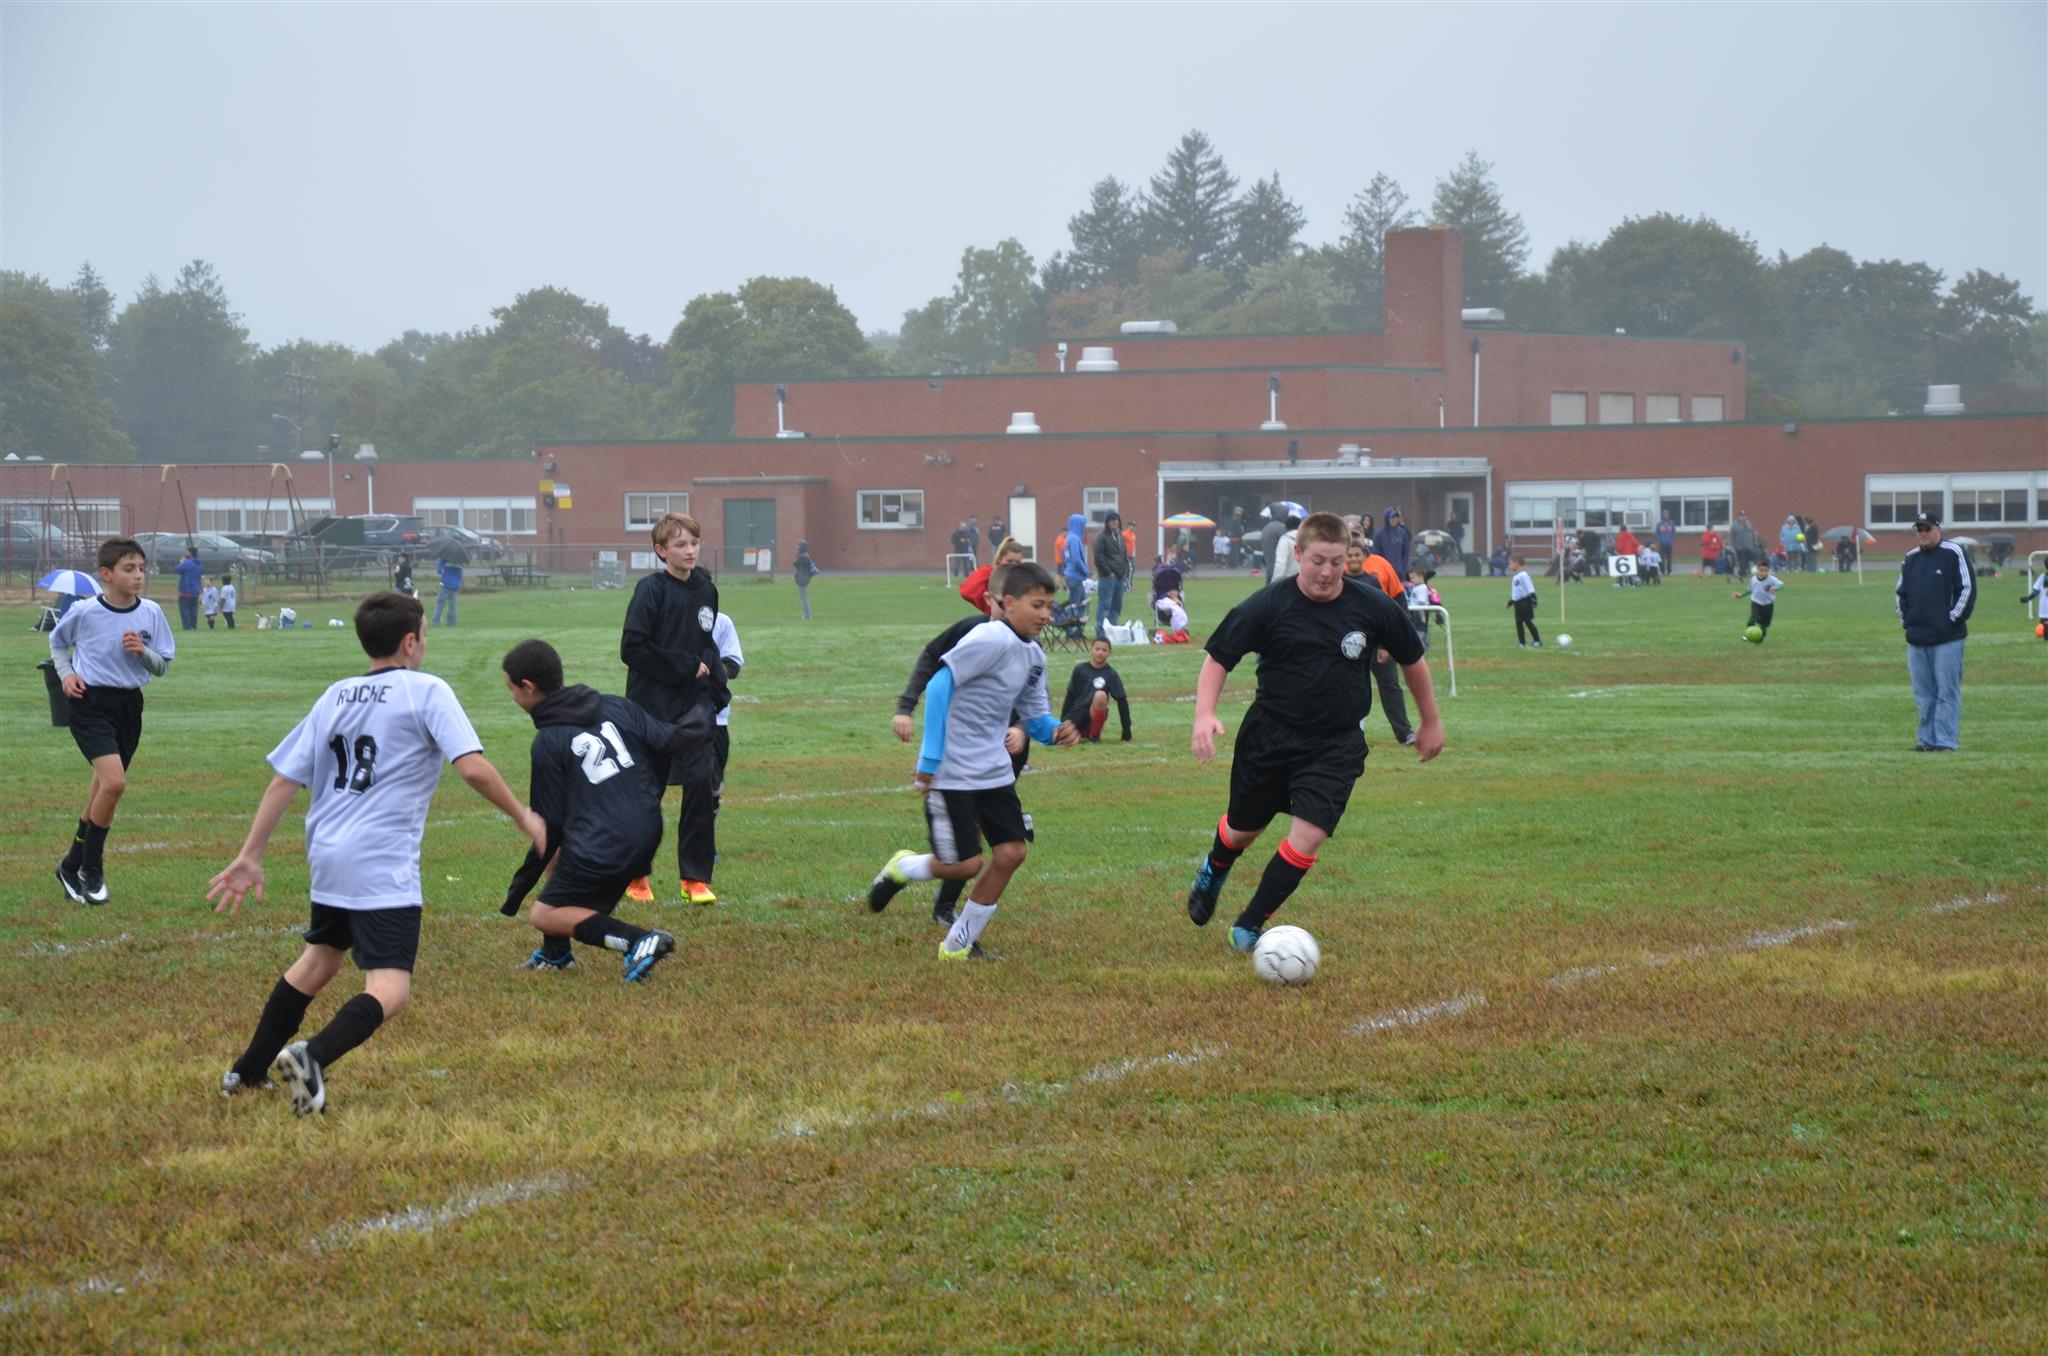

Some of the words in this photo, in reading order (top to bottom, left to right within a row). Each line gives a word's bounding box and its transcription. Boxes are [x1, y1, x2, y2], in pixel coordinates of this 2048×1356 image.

[1615, 556, 1631, 574] 6
[336, 685, 392, 706] ROCHE
[329, 734, 376, 795] 18
[570, 720, 635, 785] 21
